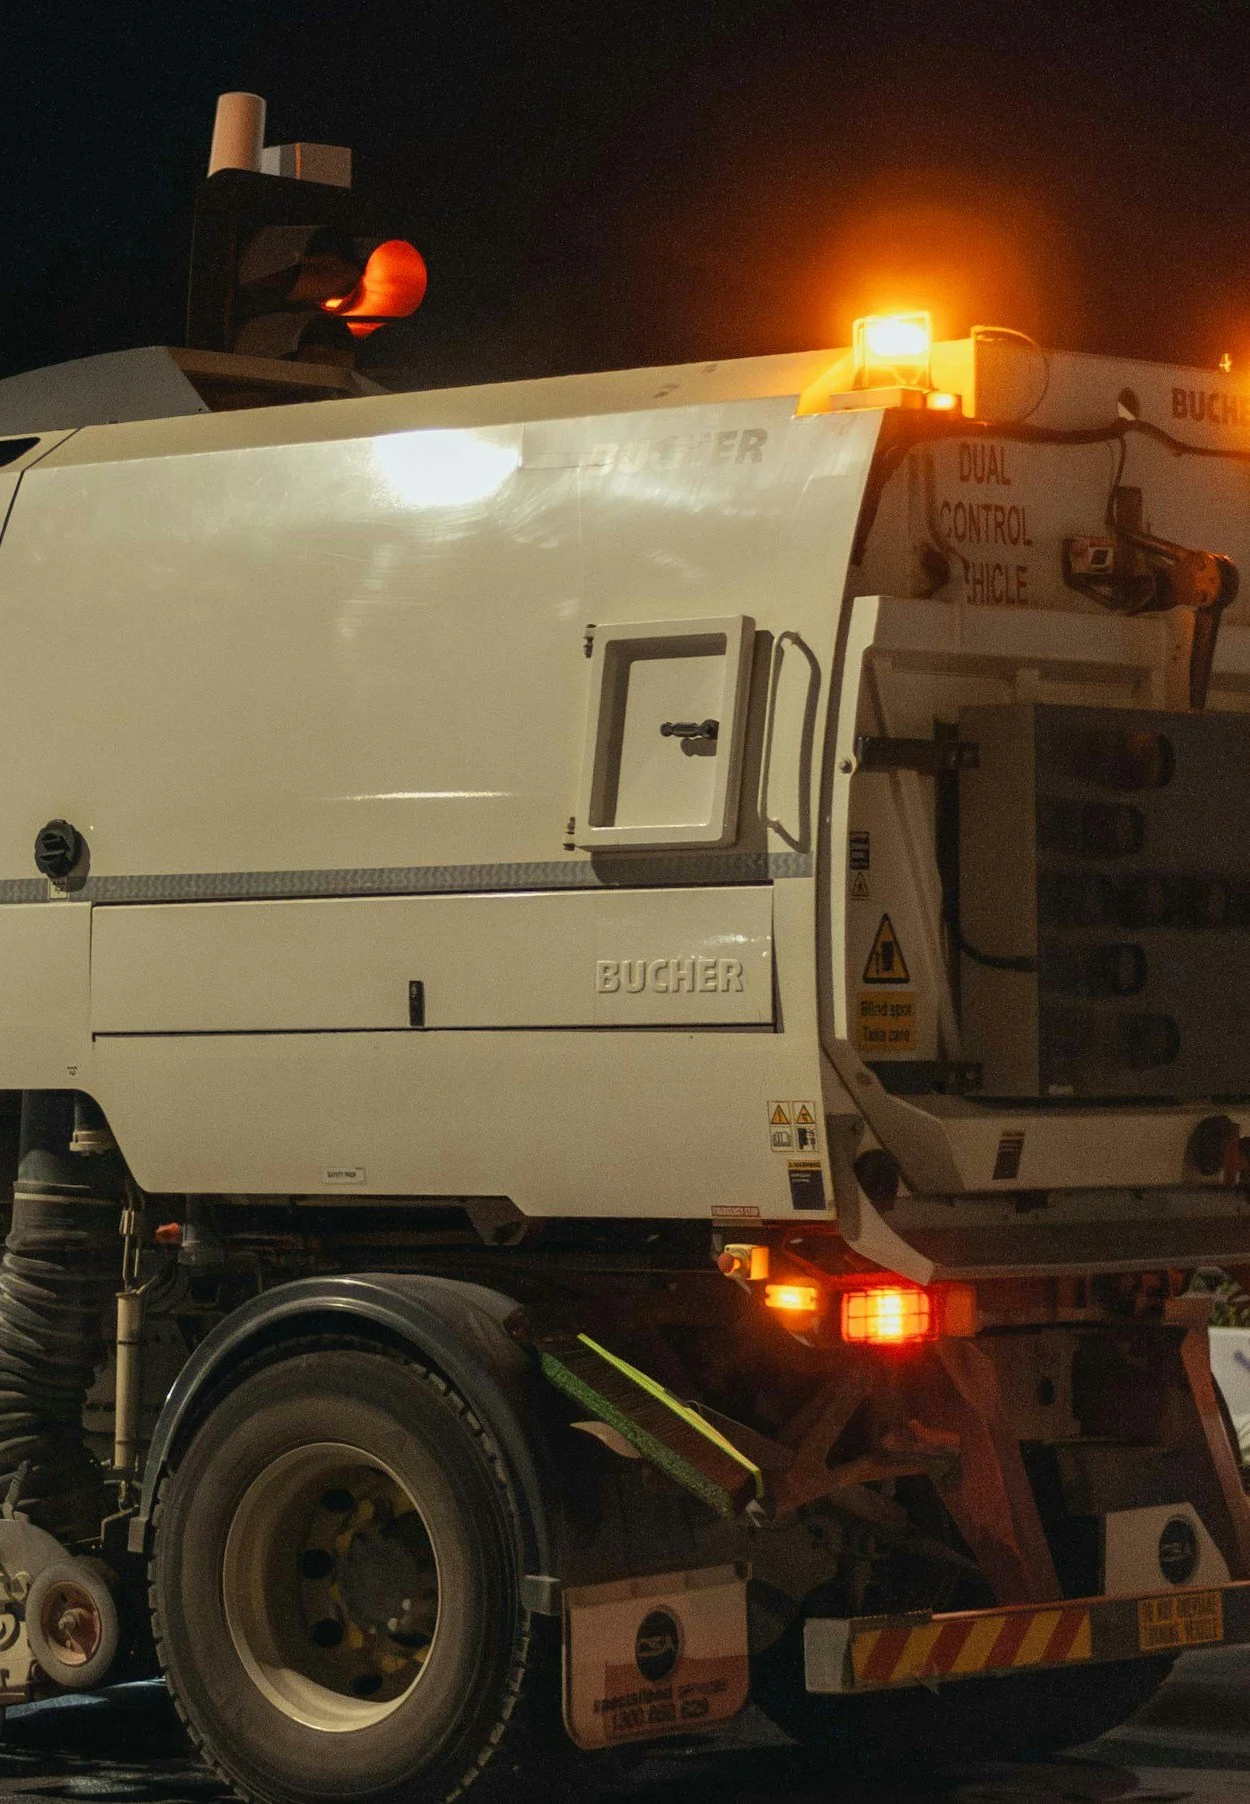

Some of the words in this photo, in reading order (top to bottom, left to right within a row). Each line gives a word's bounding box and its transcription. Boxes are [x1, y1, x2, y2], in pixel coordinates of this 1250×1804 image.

[958, 442, 1012, 485] DUAL
[939, 500, 1033, 546] CONTROL
[595, 958, 744, 994] BUCHER
